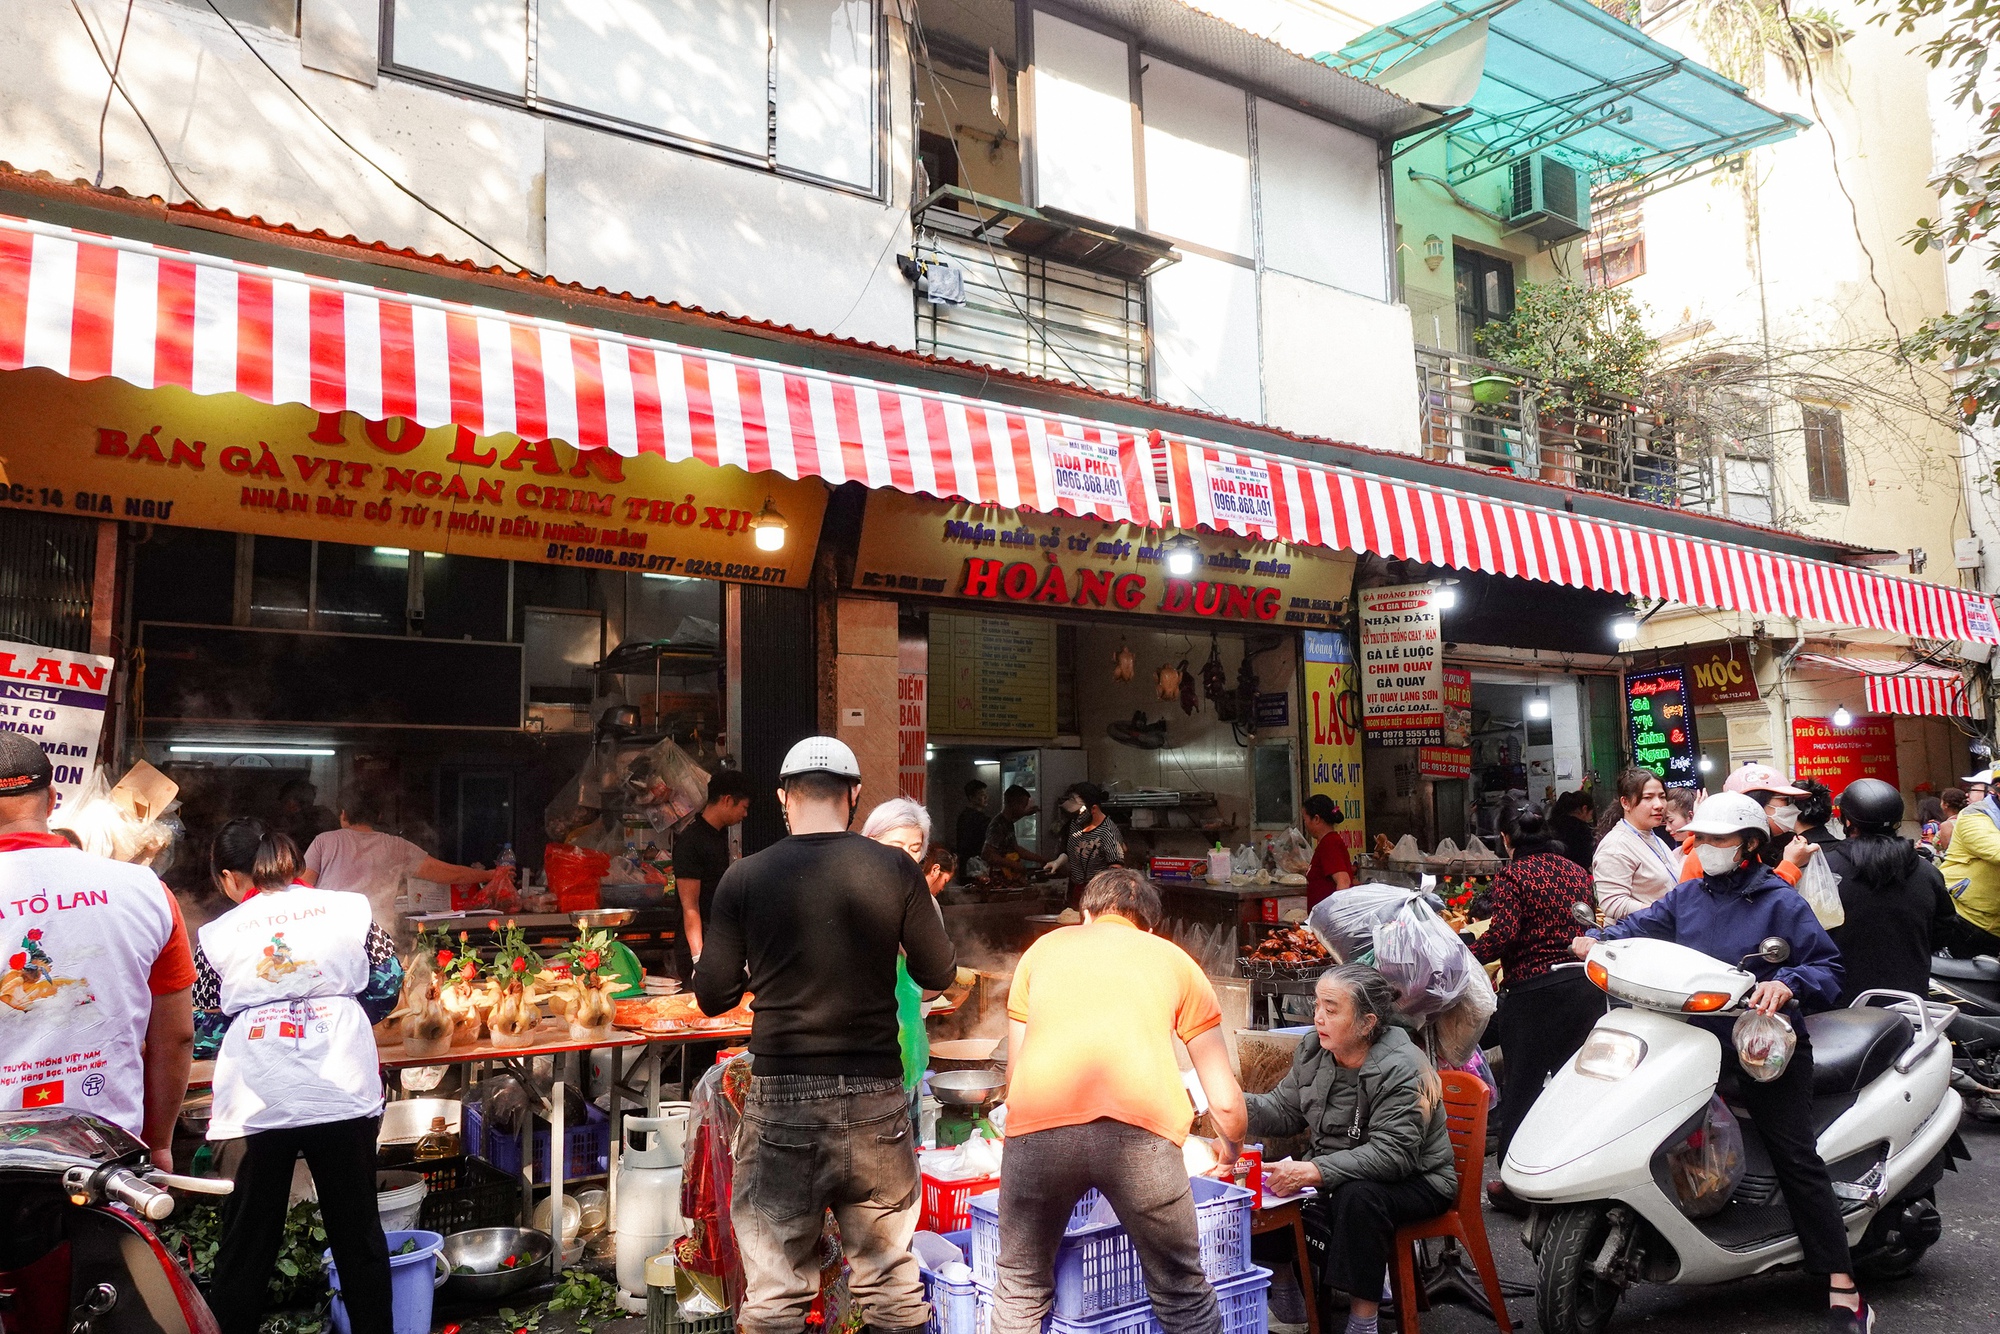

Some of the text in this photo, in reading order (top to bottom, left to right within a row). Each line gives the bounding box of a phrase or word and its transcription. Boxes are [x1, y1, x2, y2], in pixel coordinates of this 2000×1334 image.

[1053, 452, 1082, 472] HÒA
[1085, 458, 1118, 478] PHÁT
[95, 425, 698, 526] BÁN GÀ VỊT NGAN CHIM THỎ
[1056, 468, 1123, 497] 0966.868.491
[1211, 477, 1236, 495] HÒA
[1238, 481, 1269, 500] PHÁT
[38, 487, 64, 508] 14
[75, 491, 114, 514] GIA
[1213, 492, 1273, 518] 0966.868.491
[240, 485, 309, 513] NHẬN
[433, 510, 442, 528] 1
[448, 509, 495, 534] MÓN
[600, 527, 648, 550] MÂM
[961, 551, 1282, 620] HOÀNG DUNG
[1363, 588, 1433, 602] GÀ HOÀNG DUNG
[1386, 602, 1400, 610] GIA
[1364, 612, 1434, 627] NHẬN ĐẶT:
[1408, 629, 1422, 641] CHAY
[1367, 644, 1434, 661] GÀ LỄ LUỘC
[0, 651, 108, 691] LAN
[1368, 661, 1433, 675] CHIM QUAY
[1692, 654, 1744, 692] MỘC
[1377, 676, 1426, 689] GÀ QUAY
[1366, 693, 1378, 705] VỊT
[1380, 692, 1398, 703] QUAY
[1400, 690, 1420, 703] LẠNG
[1422, 689, 1439, 701] SƠN
[1632, 696, 1650, 712] Gà
[899, 703, 921, 728] BÁN
[1368, 703, 1438, 714] XÔI CÁC LOẠI...
[1382, 730, 1404, 739] 0978
[1405, 729, 1428, 738] 5555
[1429, 728, 1441, 738] 66
[1636, 731, 1666, 746] Chim
[1795, 724, 1815, 737] PHỞ
[1816, 725, 1832, 737] GÀ
[1867, 725, 1888, 736] TRÀ
[898, 730, 925, 767] CHIM
[1406, 738, 1421, 746] 287
[1424, 737, 1441, 745] 640
[1637, 747, 1670, 763] Ngan
[1431, 762, 1447, 772] 0912
[57, 889, 109, 911] LAN
[292, 905, 327, 921] LAN
[83, 1050, 102, 1060] NAM
